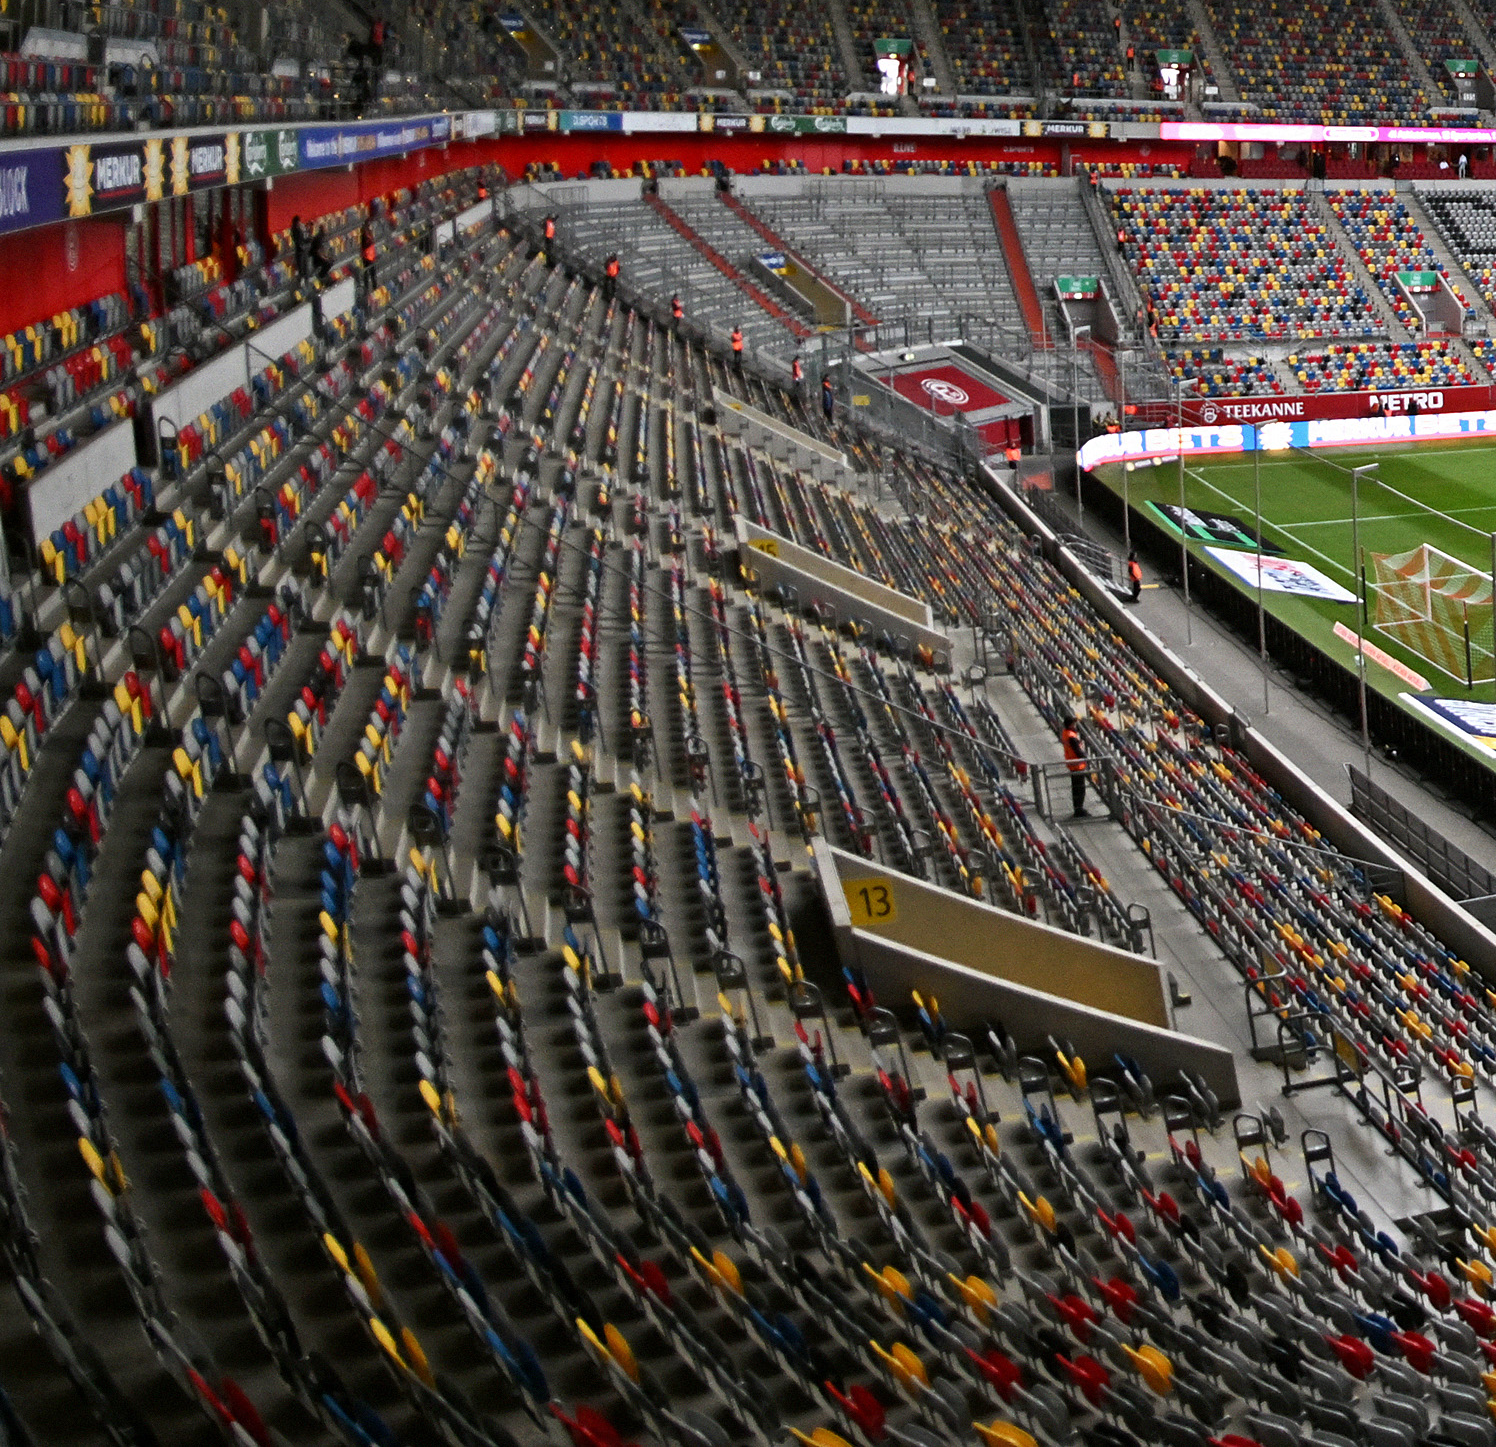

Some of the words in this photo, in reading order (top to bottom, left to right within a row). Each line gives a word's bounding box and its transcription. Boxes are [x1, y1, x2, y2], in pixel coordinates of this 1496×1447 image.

[716, 119, 746, 127] MERKUR
[1047, 125, 1084, 134] MERKUR
[96, 154, 141, 190] MERKUR
[191, 146, 223, 174] MERKUR
[1224, 402, 1304, 418] TEEKANNE
[1146, 425, 1244, 451] BETS
[1308, 416, 1411, 443] MERKUR
[859, 885, 892, 917] 13
